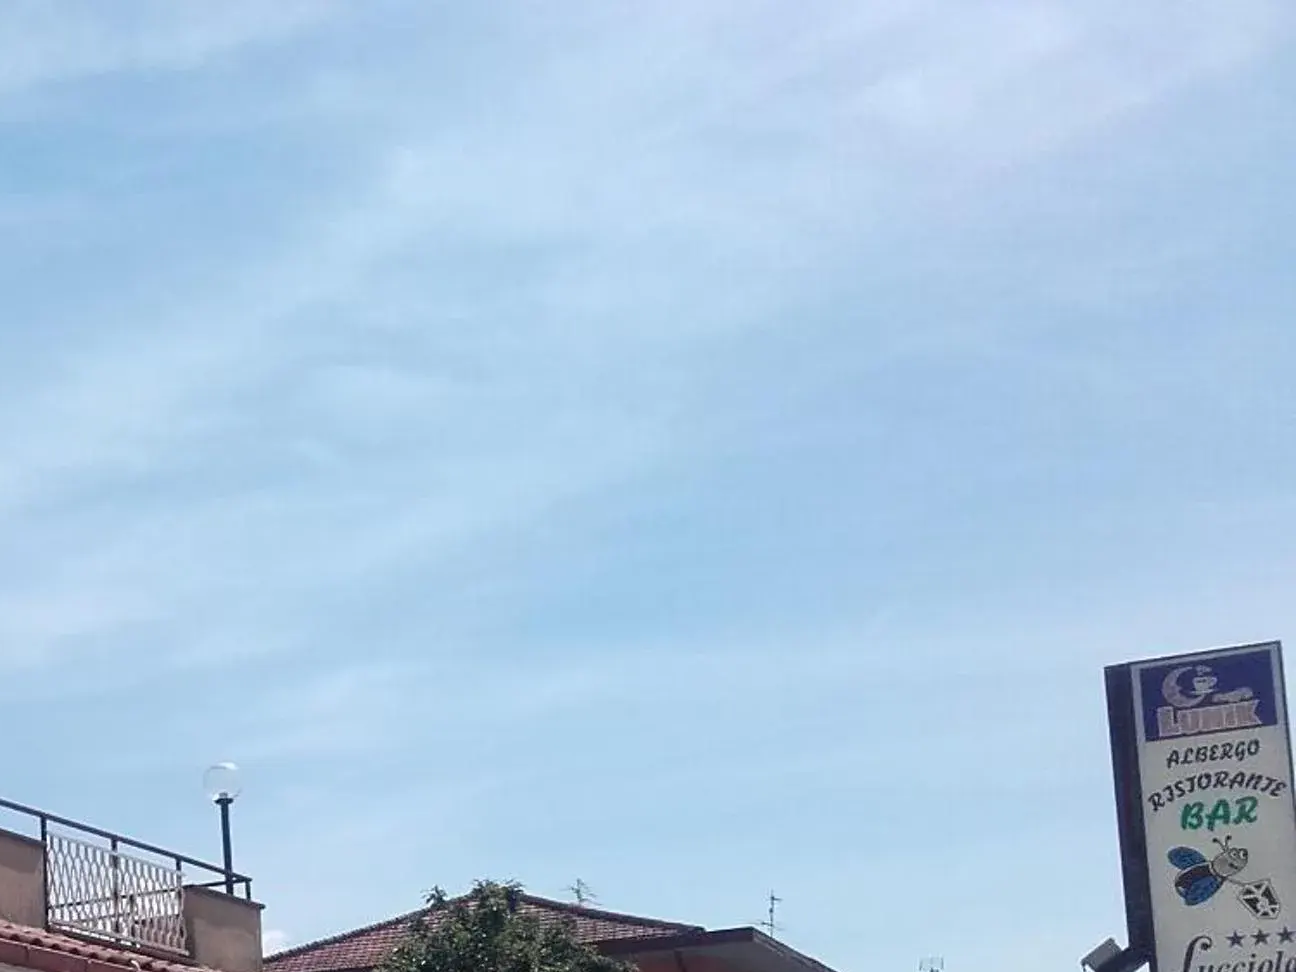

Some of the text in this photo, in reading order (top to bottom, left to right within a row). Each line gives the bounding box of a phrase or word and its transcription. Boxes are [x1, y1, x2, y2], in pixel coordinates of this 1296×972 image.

[1166, 739, 1261, 768] ALBERGO
[1148, 770, 1288, 812] RISTORANTE
[1180, 796, 1259, 831] BAR
